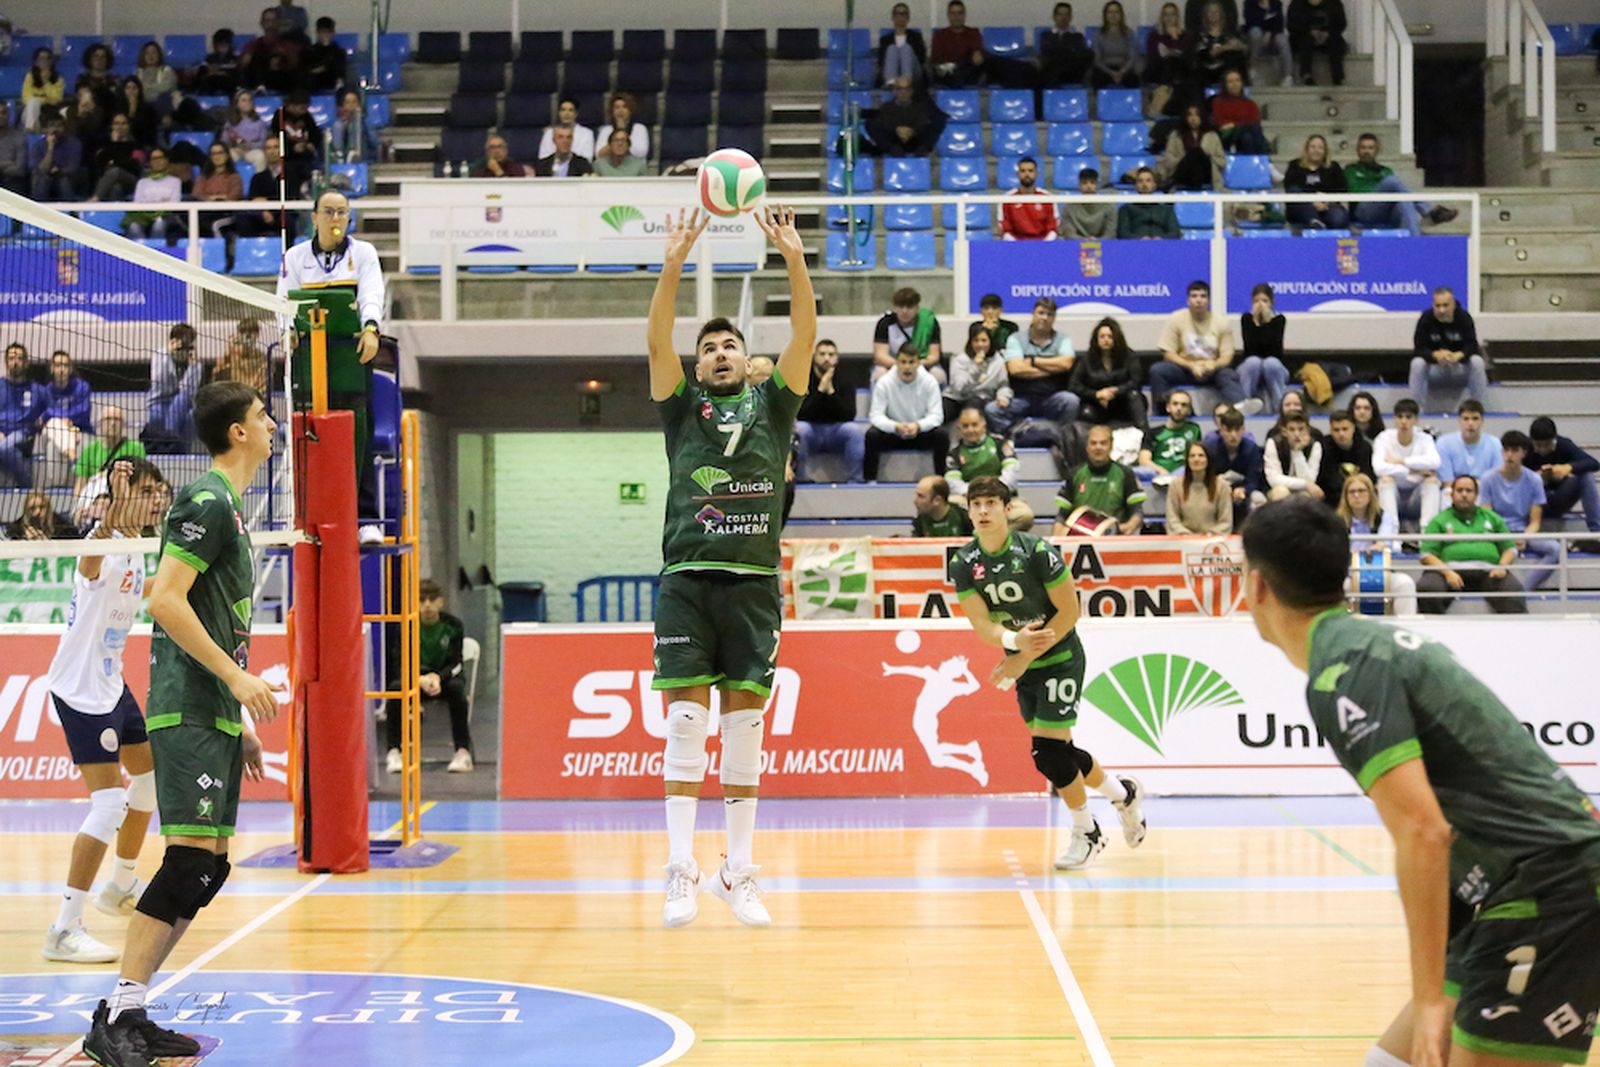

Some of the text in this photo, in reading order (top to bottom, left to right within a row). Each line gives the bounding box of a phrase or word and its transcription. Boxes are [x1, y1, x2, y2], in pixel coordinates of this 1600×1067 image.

[1010, 282, 1171, 297] DIPUTACIÓN DE ALMERÍA
[1267, 280, 1428, 295] DIPUTACIÓN DE ALMERÍA
[717, 422, 743, 456] 7
[729, 476, 774, 494] Unicaja
[717, 521, 769, 535] ALMERÍA
[726, 513, 759, 523] COSTA
[984, 580, 1024, 605] 10
[1045, 677, 1077, 703] 10
[561, 751, 668, 778] SUPERLIG
[782, 748, 905, 774] MASCULINA
[1504, 945, 1538, 996] 1
